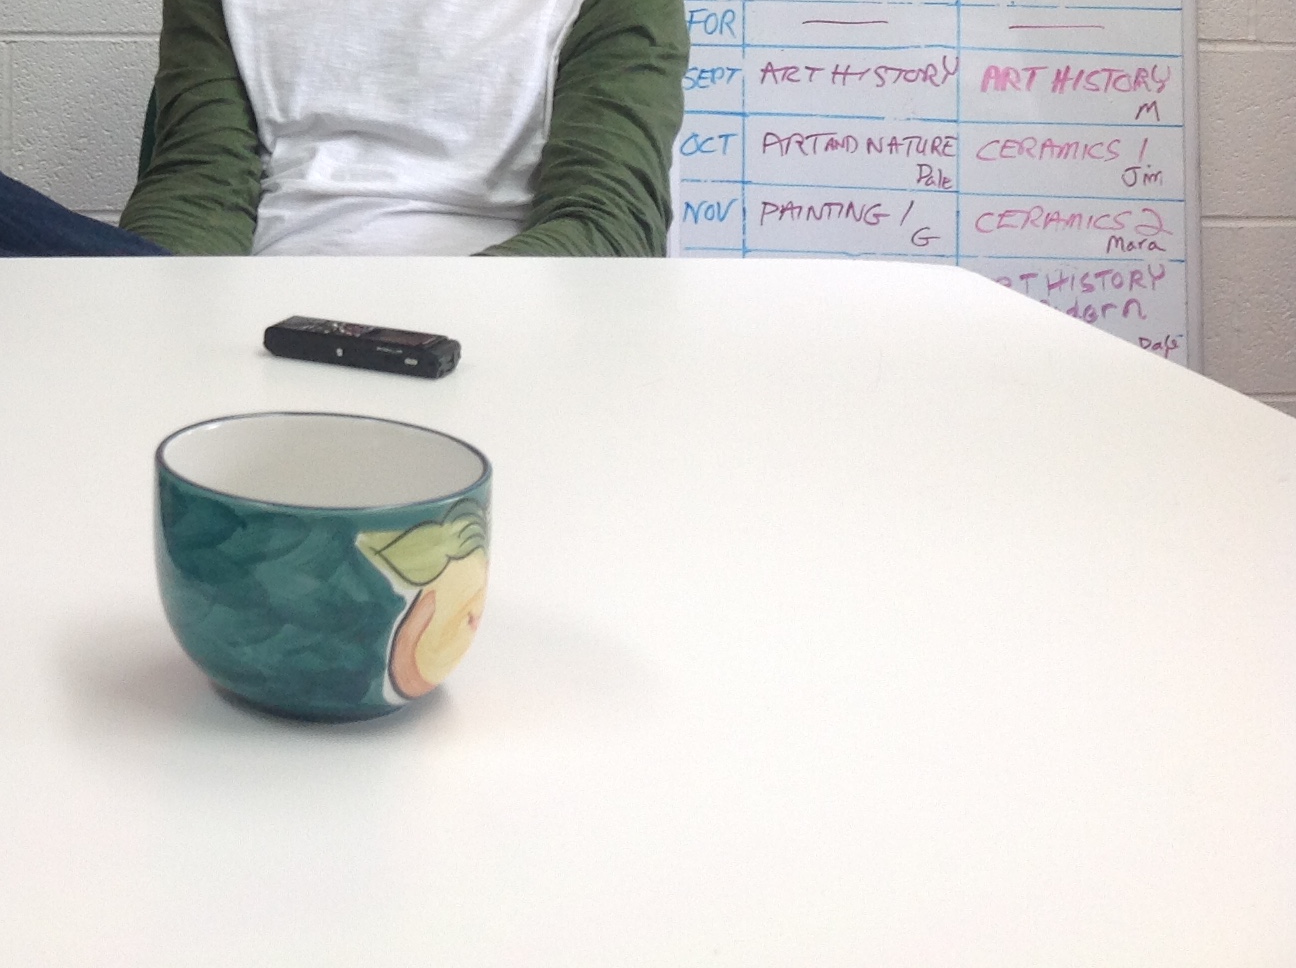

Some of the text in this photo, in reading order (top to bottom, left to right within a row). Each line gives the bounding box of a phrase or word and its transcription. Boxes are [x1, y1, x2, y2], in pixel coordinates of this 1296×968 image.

[688, 8, 736, 38] FOR
[682, 66, 742, 91] SEPT
[760, 55, 960, 88] ART HISTORY
[980, 64, 1171, 94] ART HISTORY
[1135, 100, 1161, 122] M
[680, 133, 739, 156] OCT
[866, 135, 958, 158] NATURE
[975, 136, 1122, 162] CERAMICS
[682, 198, 739, 225] NOV
[760, 200, 891, 226] PAINTING
[975, 205, 1174, 237] CERAMICS 2
[910, 227, 942, 247] G
[1105, 235, 1167, 254] Mara
[1046, 263, 1167, 297] HISTORY
